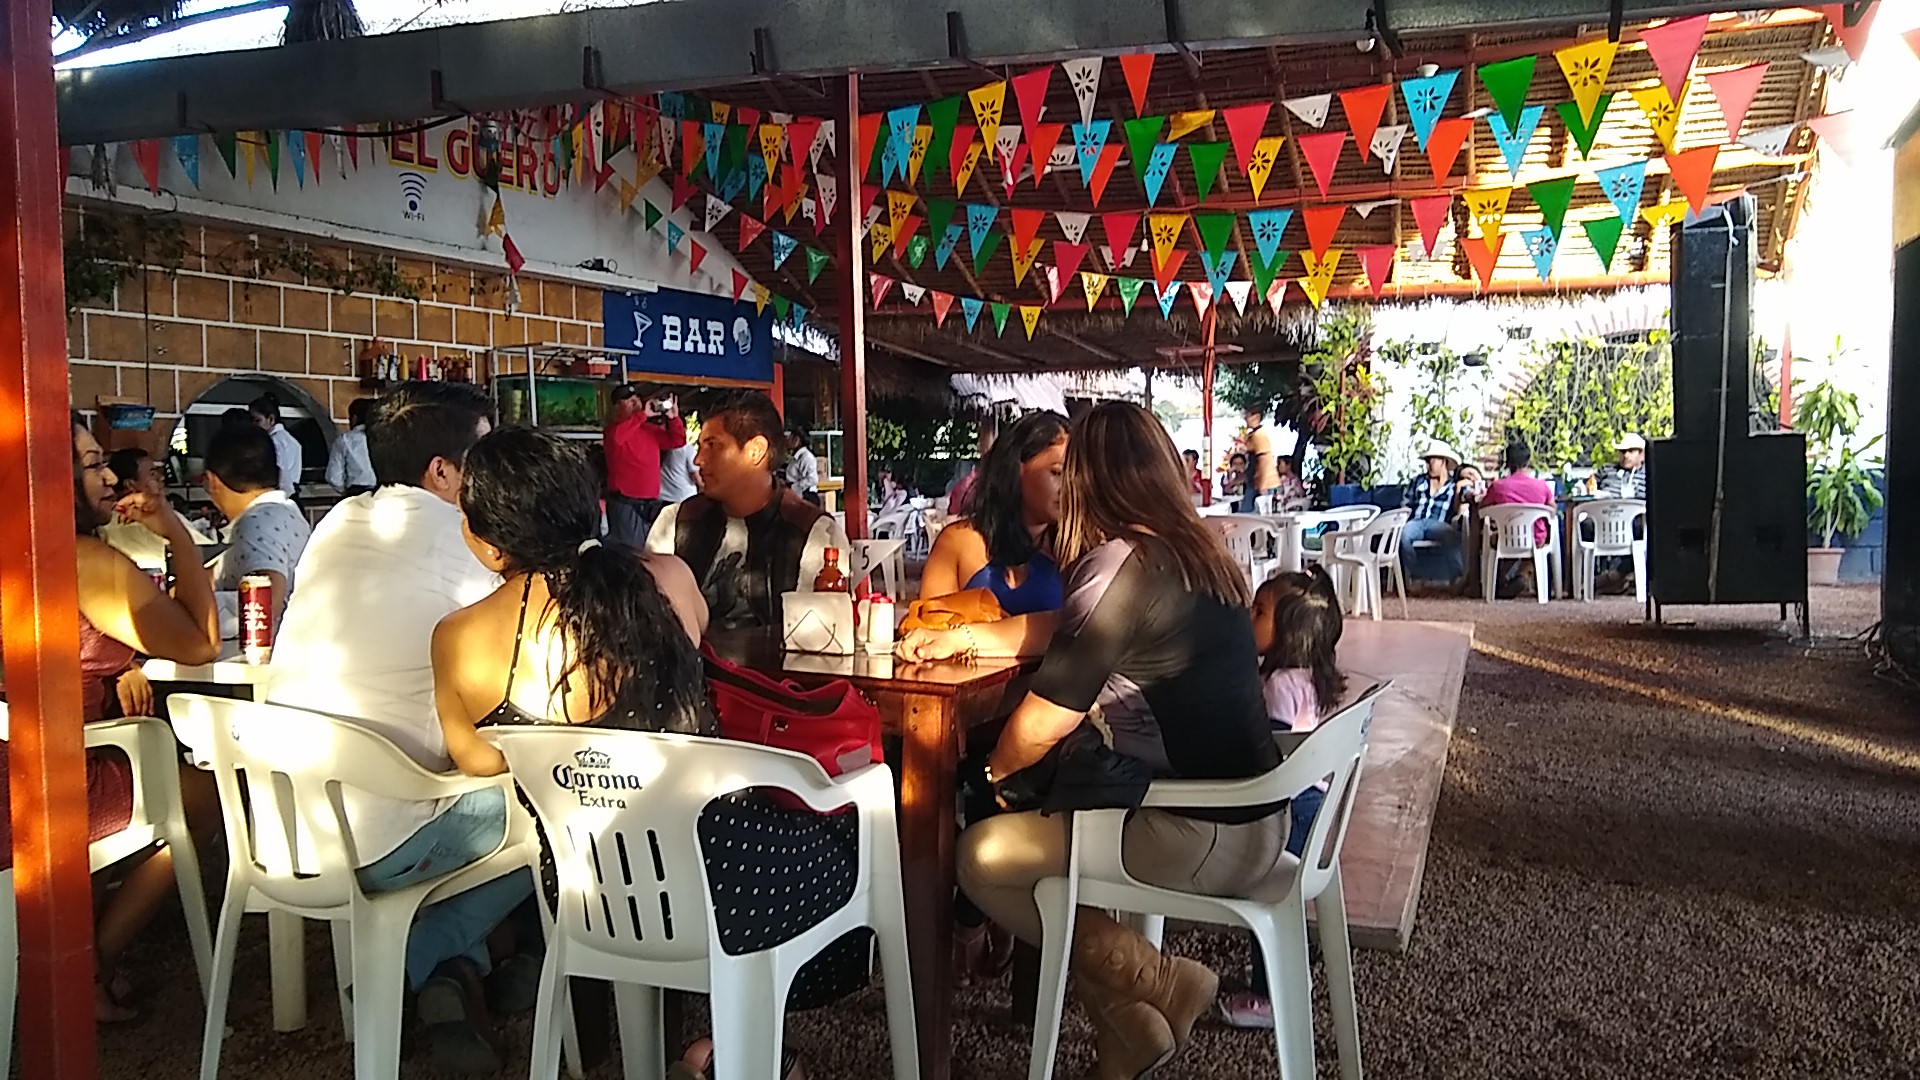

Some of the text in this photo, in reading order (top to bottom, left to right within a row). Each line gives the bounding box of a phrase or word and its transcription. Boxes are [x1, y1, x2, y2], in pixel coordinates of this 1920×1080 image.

[389, 120, 438, 172] EL
[662, 314, 725, 356] BAR
[861, 545, 870, 570] 5
[552, 764, 643, 793] Corona
[577, 790, 627, 809] Extra
